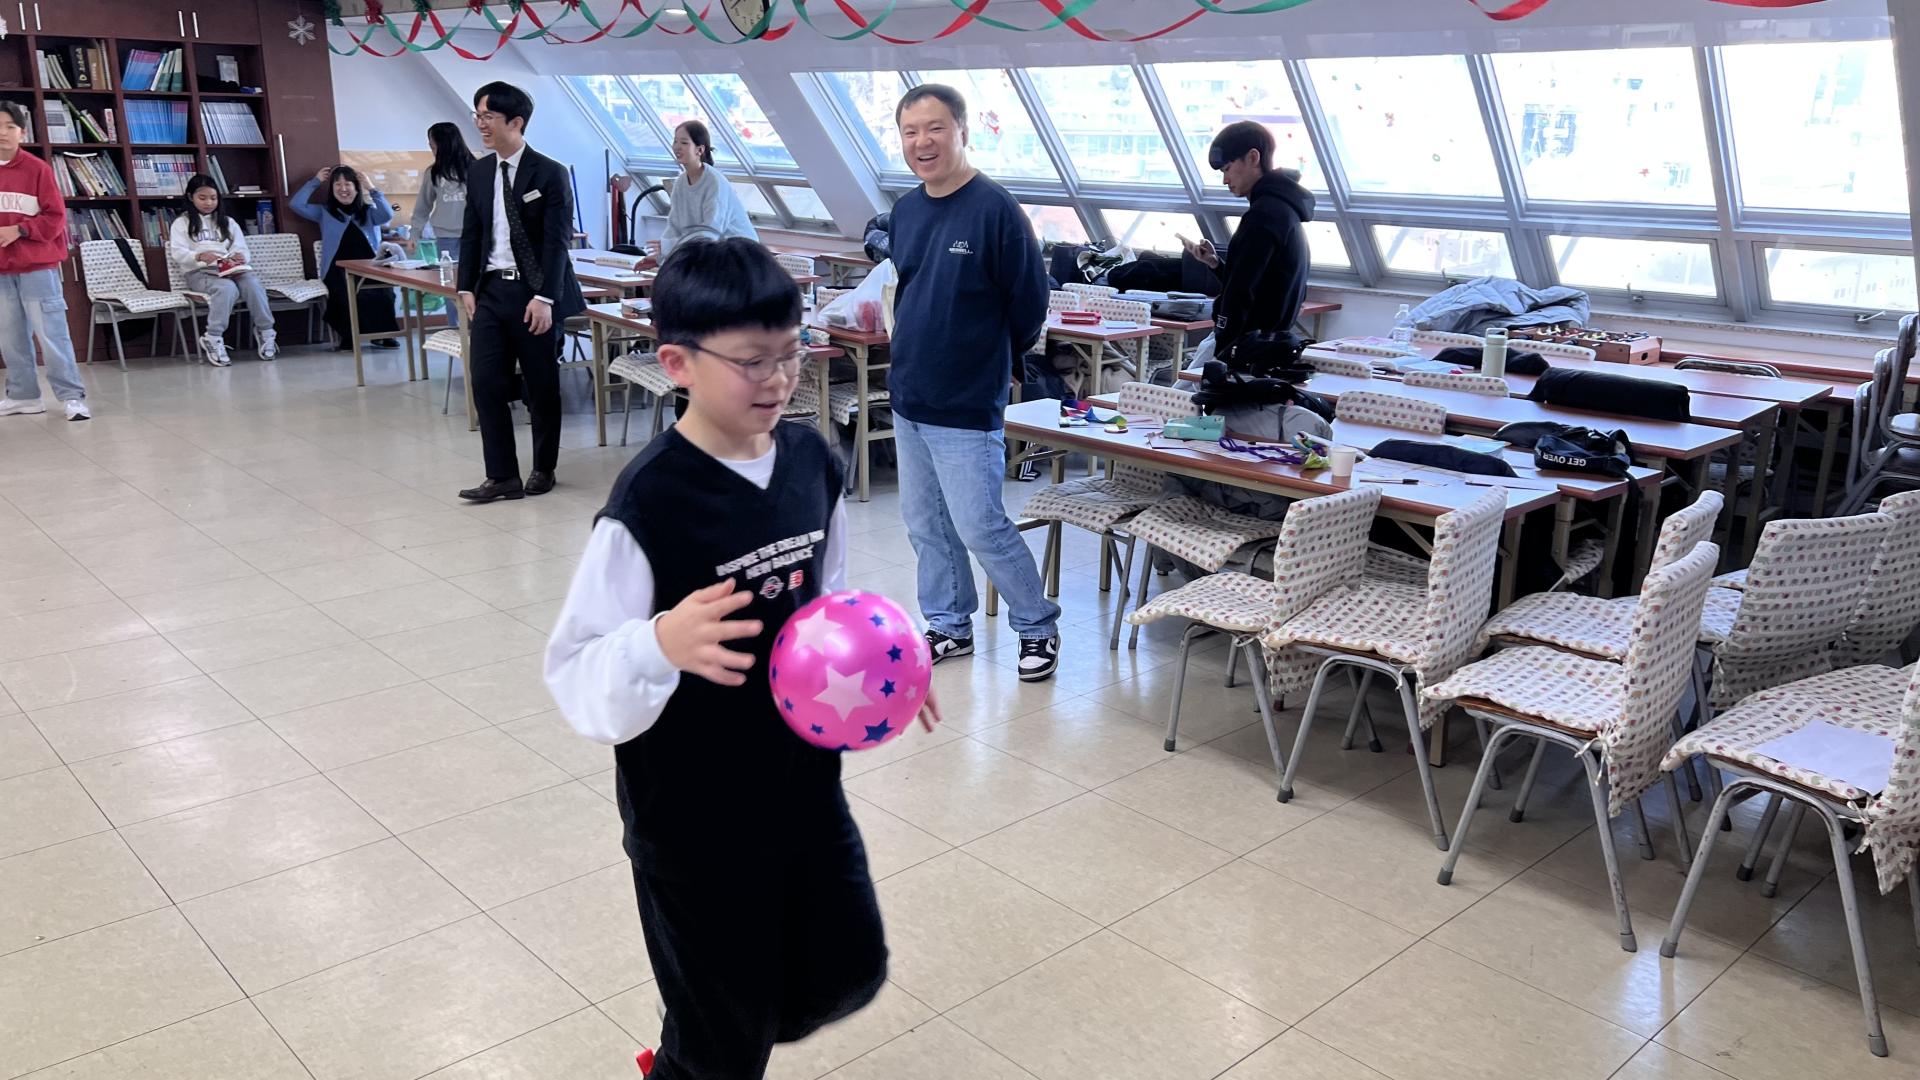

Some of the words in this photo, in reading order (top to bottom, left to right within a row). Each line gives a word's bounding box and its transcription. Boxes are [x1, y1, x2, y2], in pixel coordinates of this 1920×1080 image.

[0, 194, 22, 210] ORK
[1543, 452, 1566, 464] OVER
[1567, 457, 1587, 467] GET
[745, 560, 773, 580] NEW
